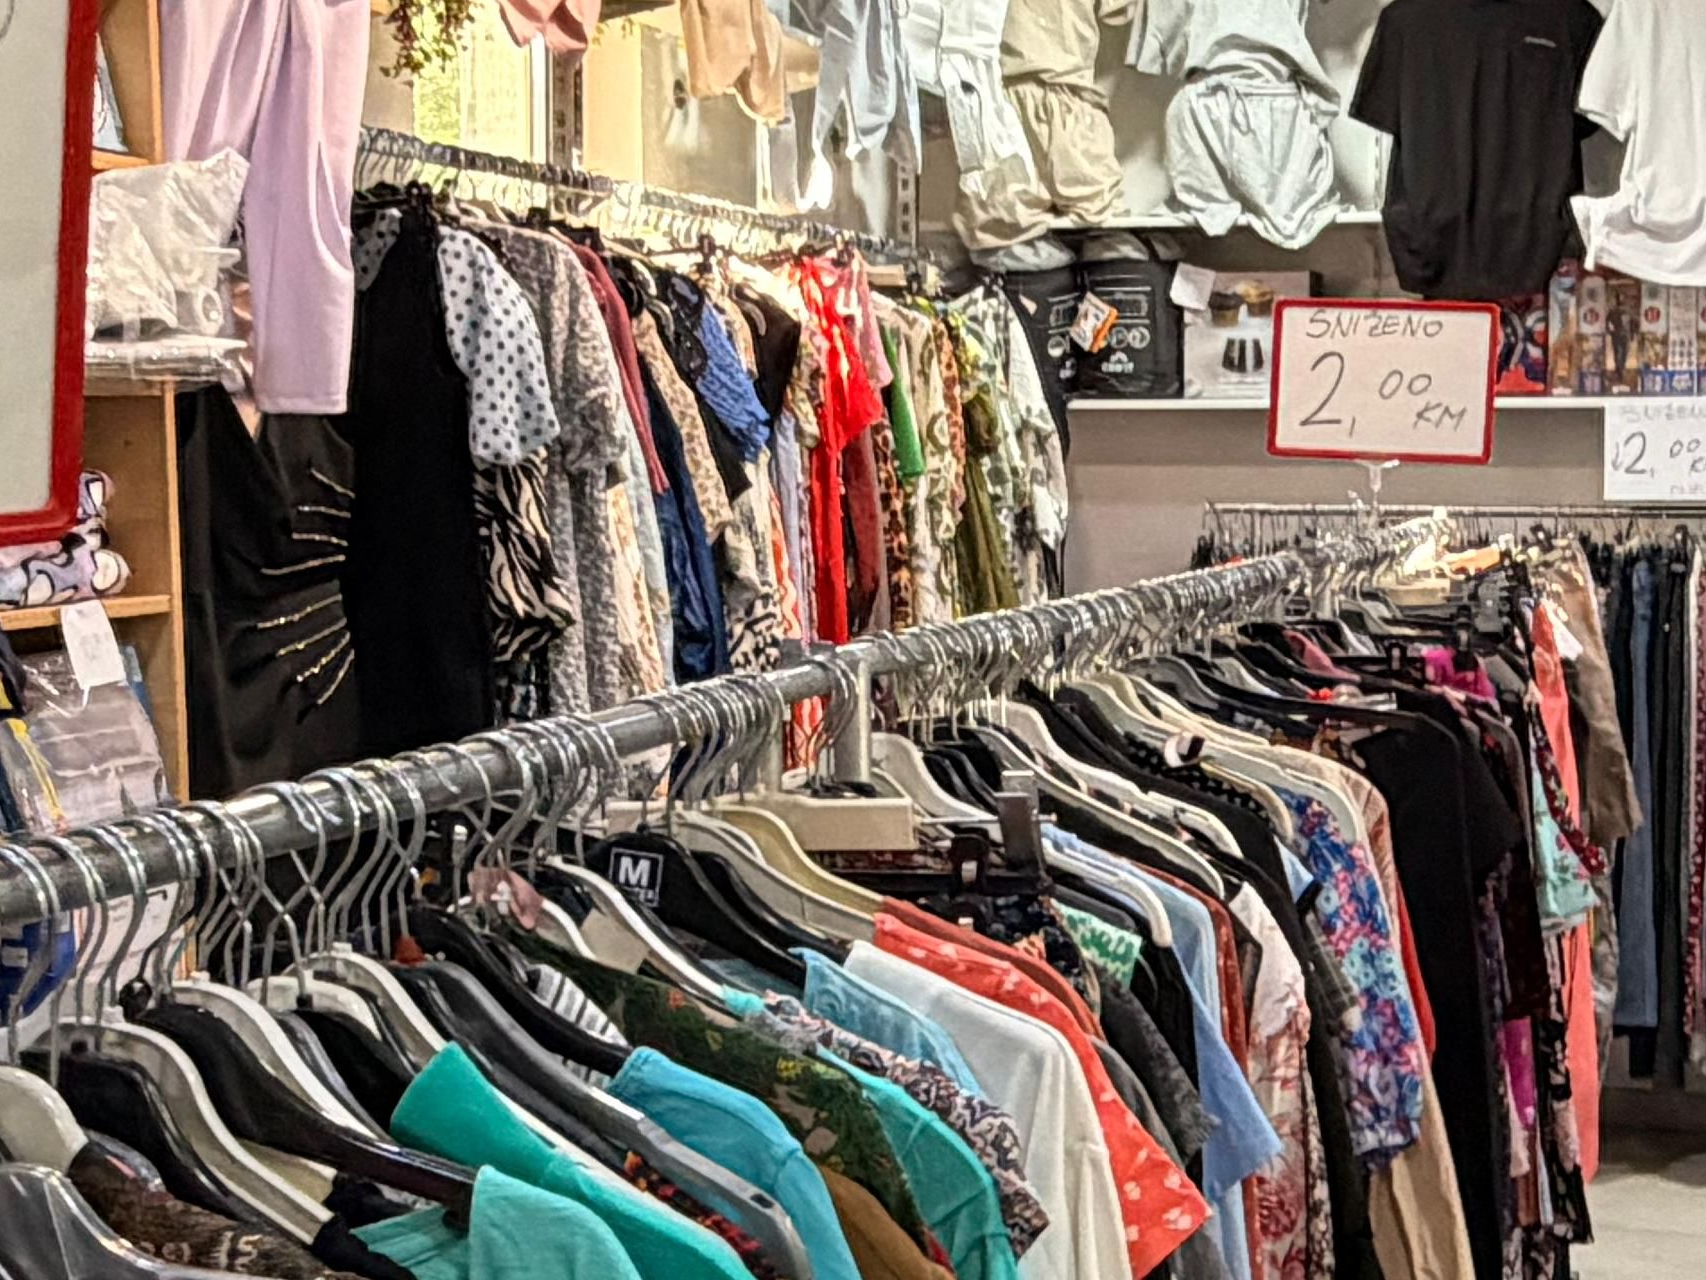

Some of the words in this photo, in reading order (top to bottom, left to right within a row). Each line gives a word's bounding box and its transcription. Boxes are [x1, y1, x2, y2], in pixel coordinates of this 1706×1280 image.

[1306, 309, 1444, 339] SNIŽENO
[1412, 401, 1467, 433] KM
[618, 855, 652, 888] M
